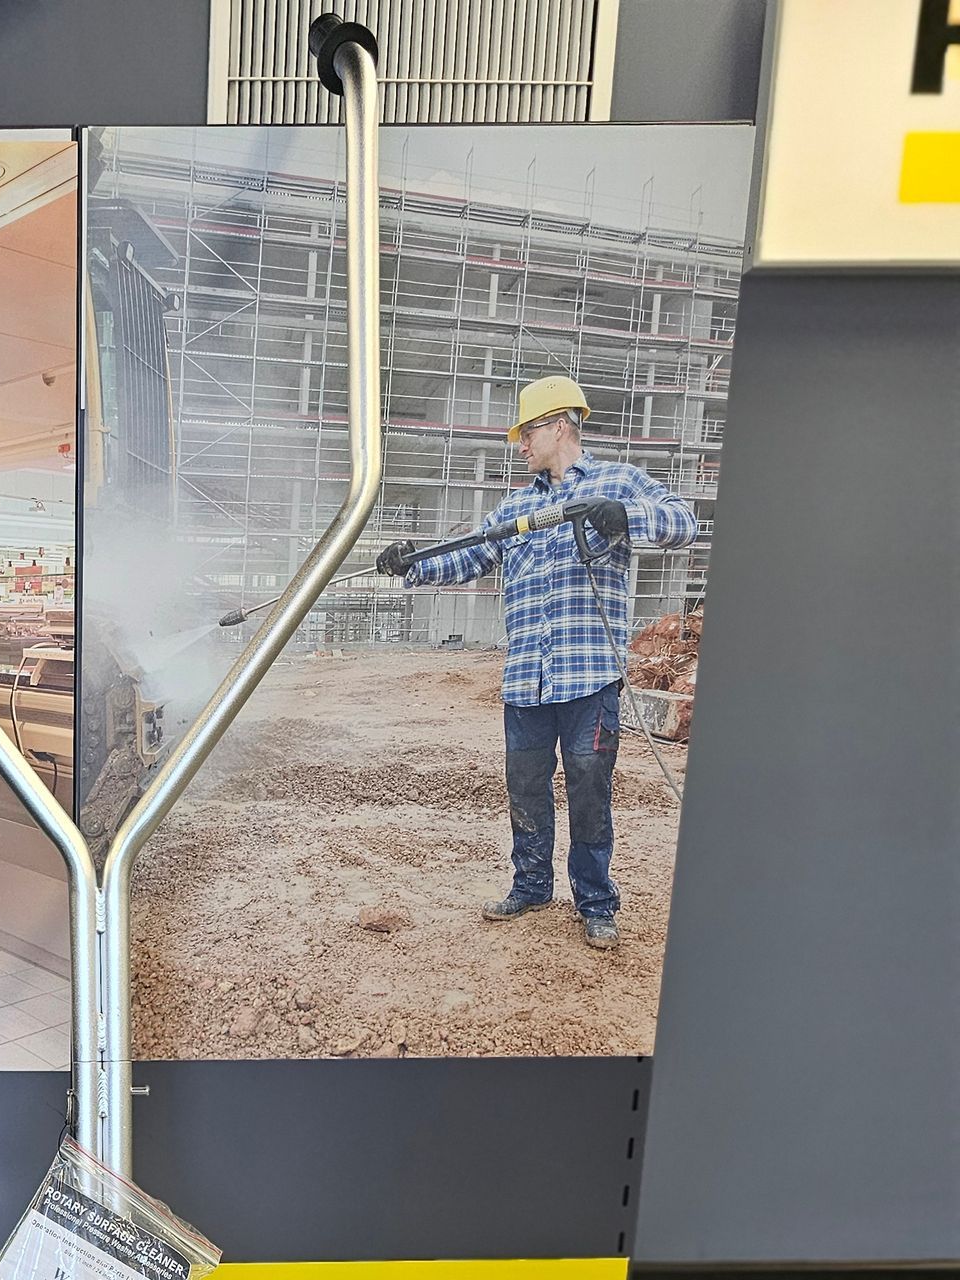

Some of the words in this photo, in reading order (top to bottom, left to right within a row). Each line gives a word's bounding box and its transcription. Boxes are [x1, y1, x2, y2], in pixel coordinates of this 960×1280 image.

[43, 1197, 83, 1225] Professional
[82, 1220, 111, 1242] Pressure
[110, 1237, 136, 1257] Washer
[44, 1185, 88, 1216] ROTARY
[86, 1209, 136, 1245] SURFACE
[134, 1239, 186, 1275] CLEANER
[62, 1236, 96, 1260] Instruction
